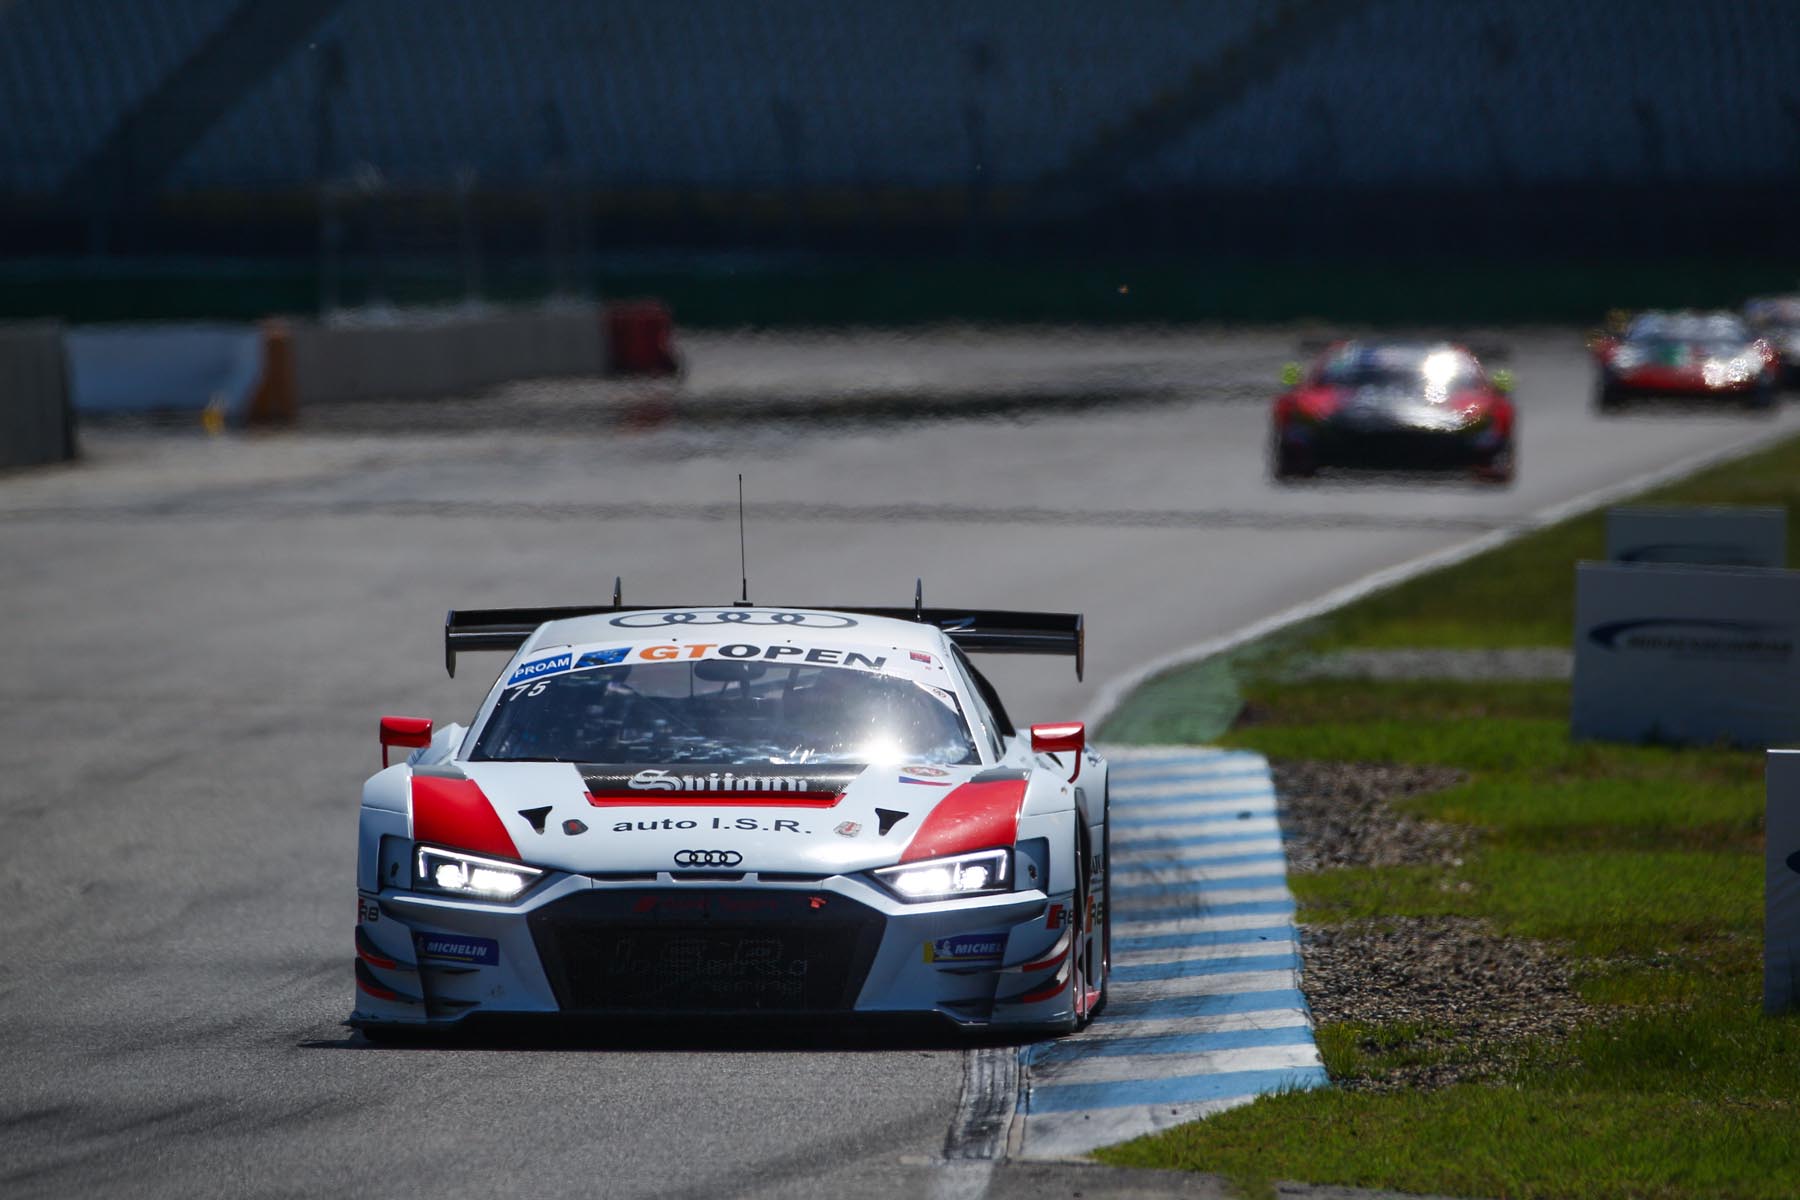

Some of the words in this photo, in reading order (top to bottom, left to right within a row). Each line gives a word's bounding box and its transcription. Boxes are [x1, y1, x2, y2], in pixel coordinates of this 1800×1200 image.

[514, 655, 571, 680] PROAM
[509, 680, 552, 701] 75
[612, 817, 698, 833] auto
[712, 817, 813, 835] I.S.R.
[427, 942, 488, 957] MICHELIN
